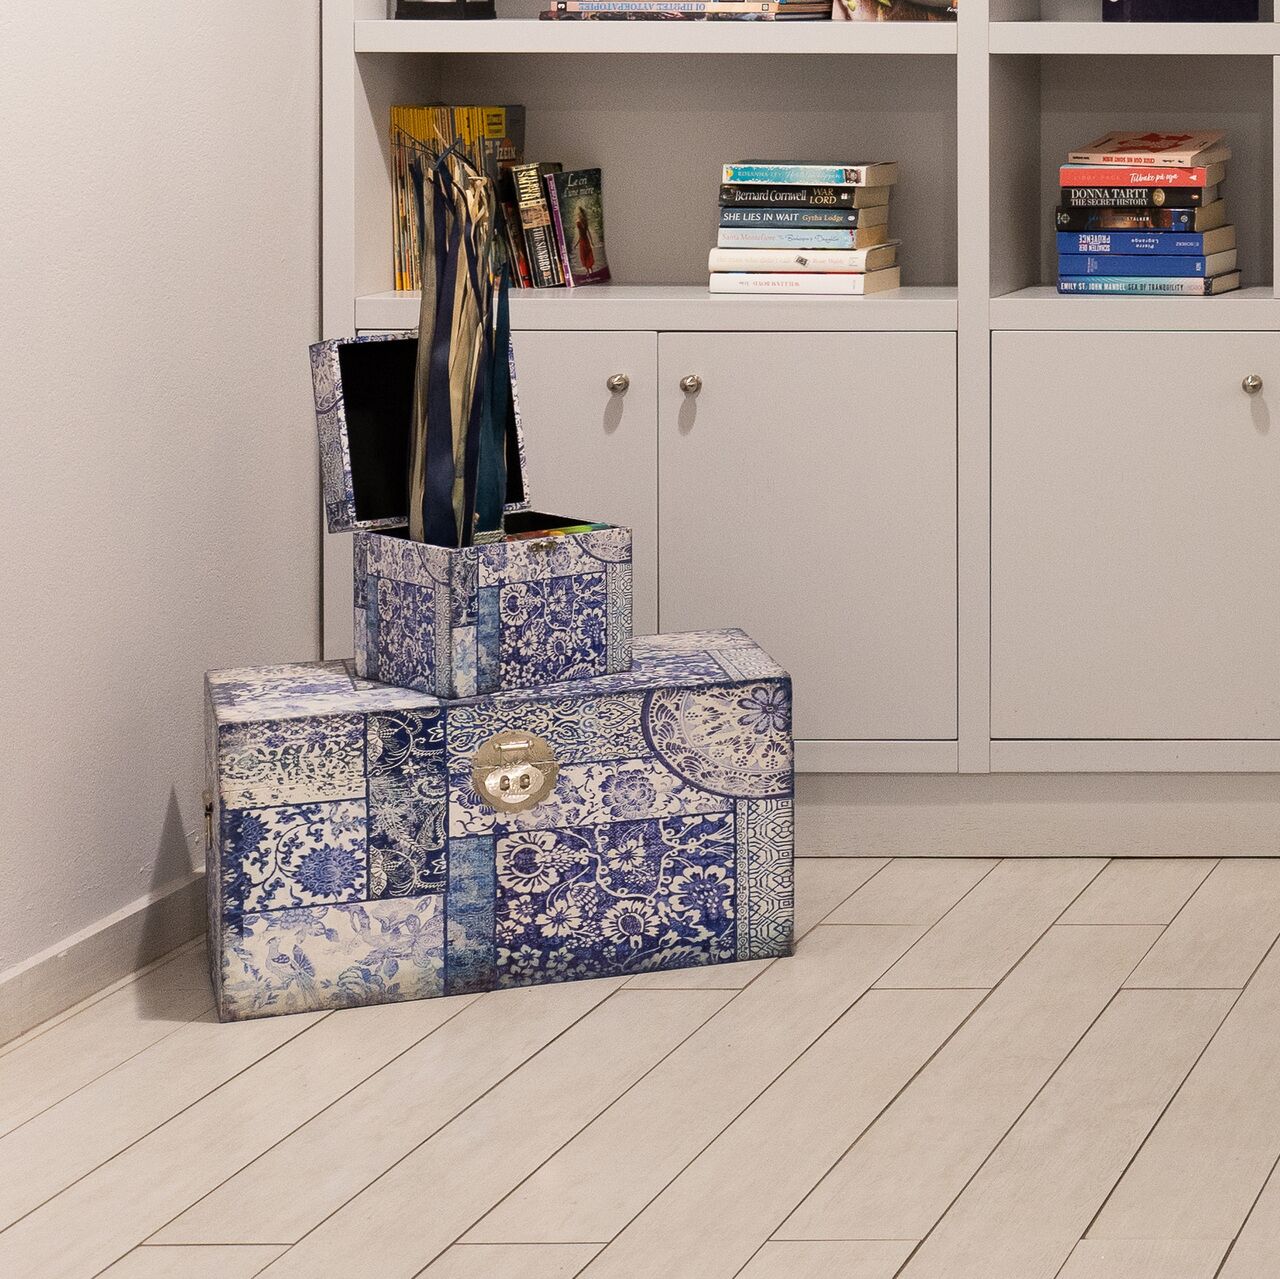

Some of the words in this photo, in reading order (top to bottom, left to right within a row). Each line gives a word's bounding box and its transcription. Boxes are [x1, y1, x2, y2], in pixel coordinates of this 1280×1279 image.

[528, 167, 542, 200] WILBUR
[567, 174, 579, 187] Le
[516, 171, 531, 202] SMITH
[735, 189, 770, 202] Bernard
[769, 189, 807, 201] Cornwell
[813, 187, 834, 197] WAR
[1071, 189, 1110, 199] DONNA
[1111, 189, 1149, 199] TARTT
[809, 195, 837, 205] LORD
[1070, 198, 1087, 206] THE
[723, 212, 741, 221] SHE
[743, 212, 761, 221] LIES
[763, 213, 773, 221] IN
[776, 213, 800, 221] WAIT
[802, 214, 822, 223] Gytha
[824, 214, 844, 222] Lodge
[1078, 234, 1111, 244] PROVENCE
[1078, 244, 1088, 252] DER
[536, 241, 551, 273] SUNBIRD
[1060, 282, 1076, 291] EMILY
[1088, 283, 1102, 291] JOHN
[1103, 283, 1126, 291] MANDEL
[1127, 283, 1139, 291] SEA
[1148, 284, 1184, 292] TRANQUILITY
